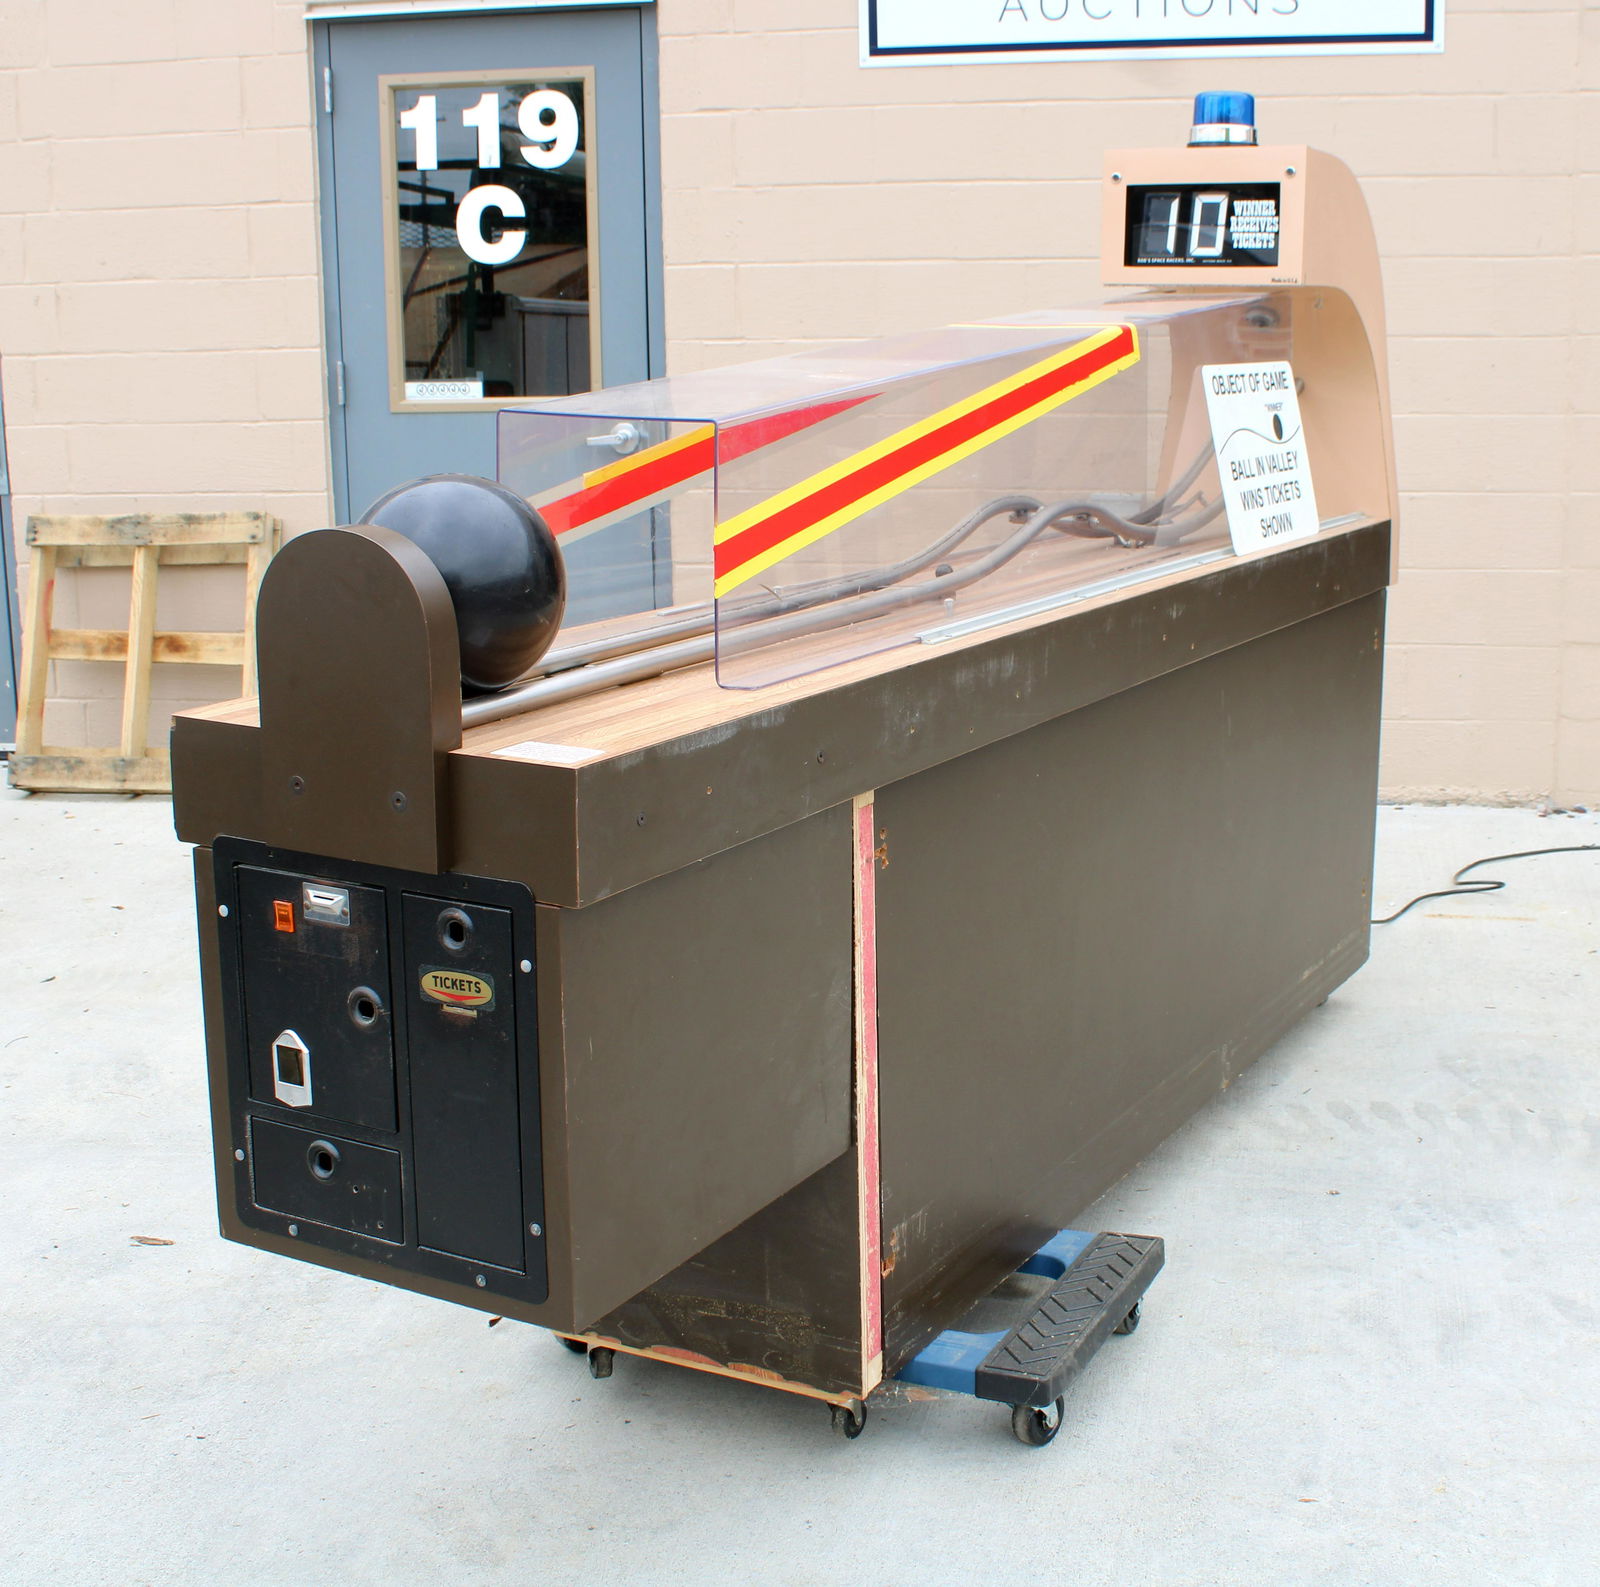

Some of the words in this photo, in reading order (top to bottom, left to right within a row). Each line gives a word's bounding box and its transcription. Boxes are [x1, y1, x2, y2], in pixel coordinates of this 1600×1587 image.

[400, 89, 579, 170] 119
[1233, 199, 1276, 216] WINNER
[456, 184, 528, 265] C
[1166, 194, 1229, 257] 10
[1230, 216, 1279, 232] RECEIVES
[1231, 232, 1276, 249] TICKETS
[1212, 374, 1246, 395] OBJECT
[1248, 373, 1260, 391] OF
[1262, 371, 1289, 390] GAME
[1231, 459, 1256, 481] BALL
[1256, 457, 1265, 476] IN
[1266, 451, 1299, 474] VALLEY
[1240, 488, 1264, 511] WINS
[1265, 481, 1301, 506] TICKETS
[1260, 513, 1293, 538] SHOWN
[432, 975, 481, 993] TICKETS
